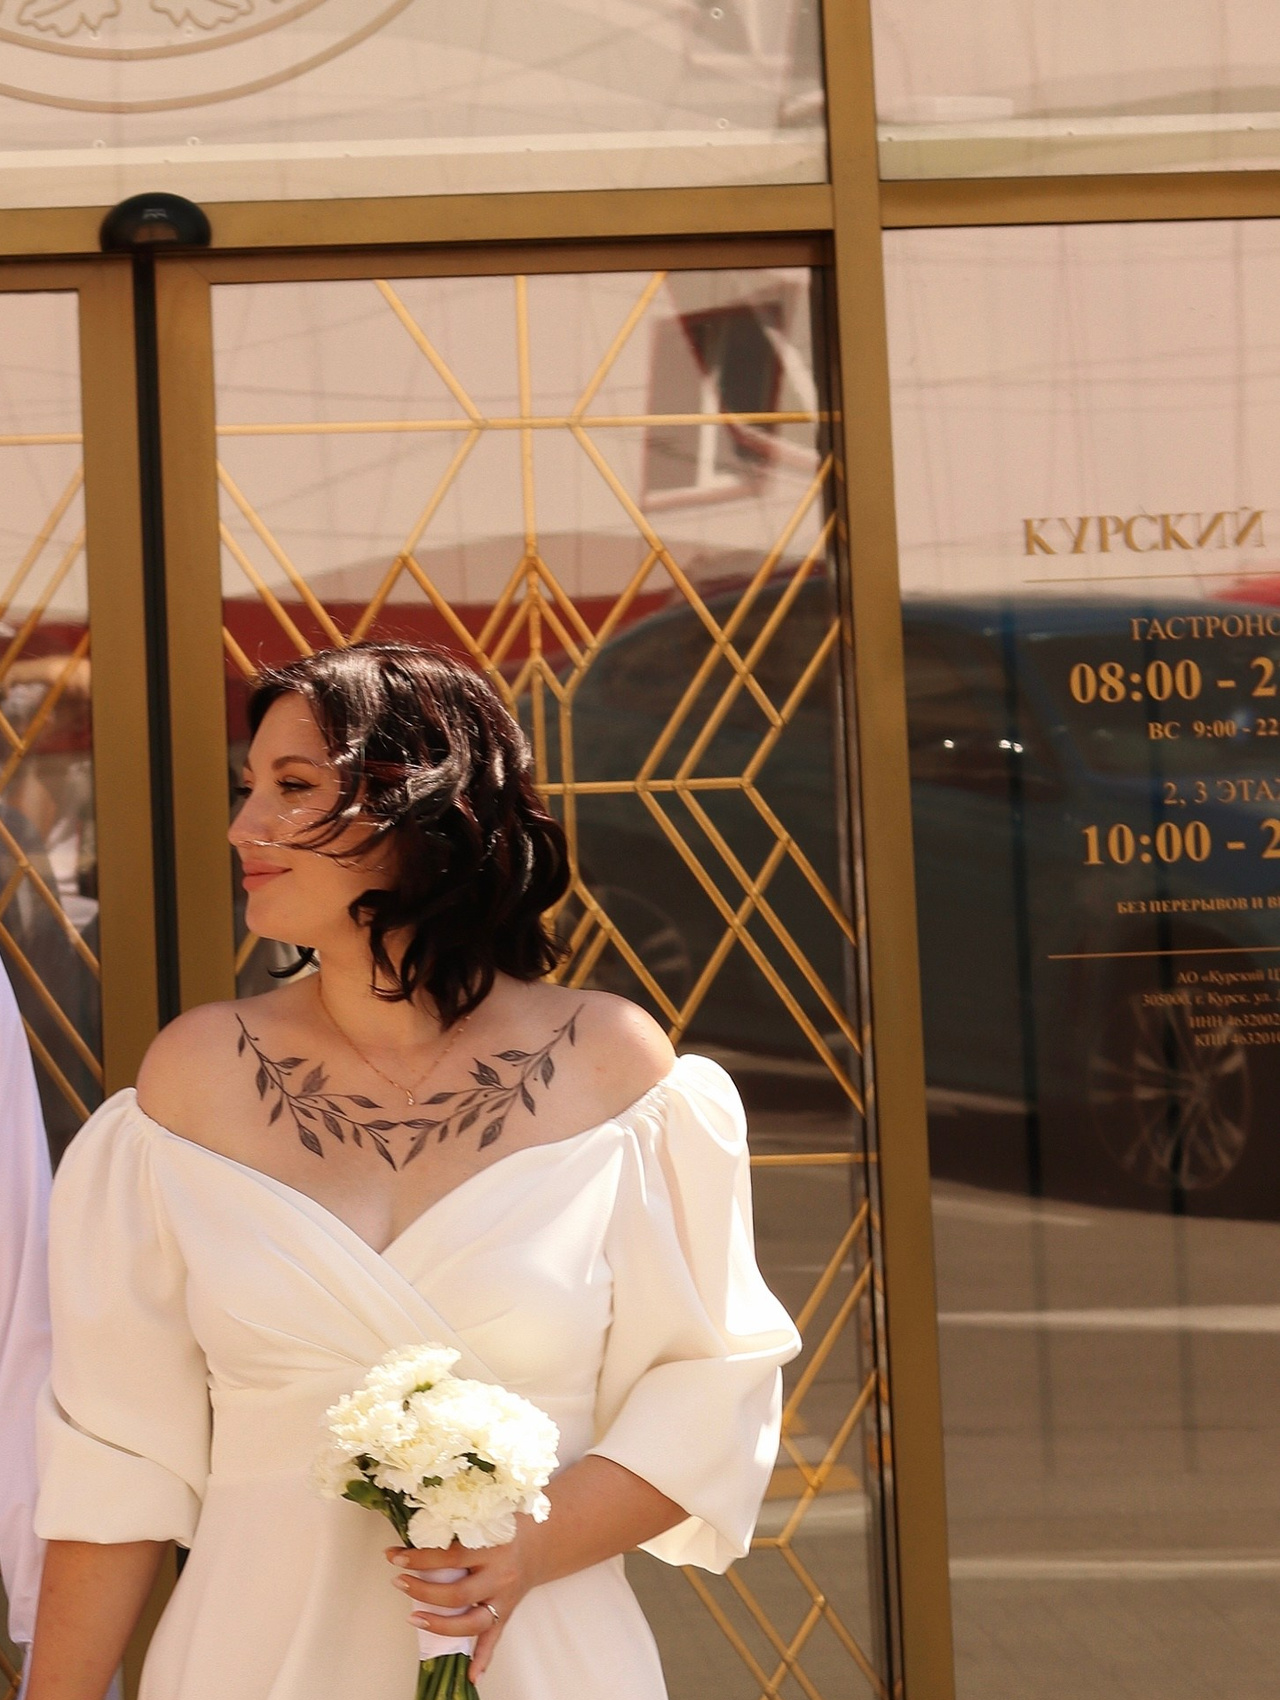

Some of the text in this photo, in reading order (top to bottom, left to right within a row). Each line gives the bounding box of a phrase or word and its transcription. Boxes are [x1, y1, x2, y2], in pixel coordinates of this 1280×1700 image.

[1023, 506, 1265, 556] КУРСКИЙ
[1070, 656, 1280, 703] 08:00 - 2
[1148, 721, 1180, 740] ВС
[1193, 719, 1237, 739] 9:00
[1256, 717, 1280, 737] 22
[1163, 777, 1280, 809] 2, 3 ЭТА
[1082, 819, 1212, 866] 10:00
[1226, 841, 1246, 850] -
[1116, 895, 1280, 914] БЕЗ ПЕРЕРЫВОВ И В
[1177, 970, 1199, 984] АО
[1188, 1015, 1223, 1029] ИНН
[1194, 1033, 1228, 1047] КПП
